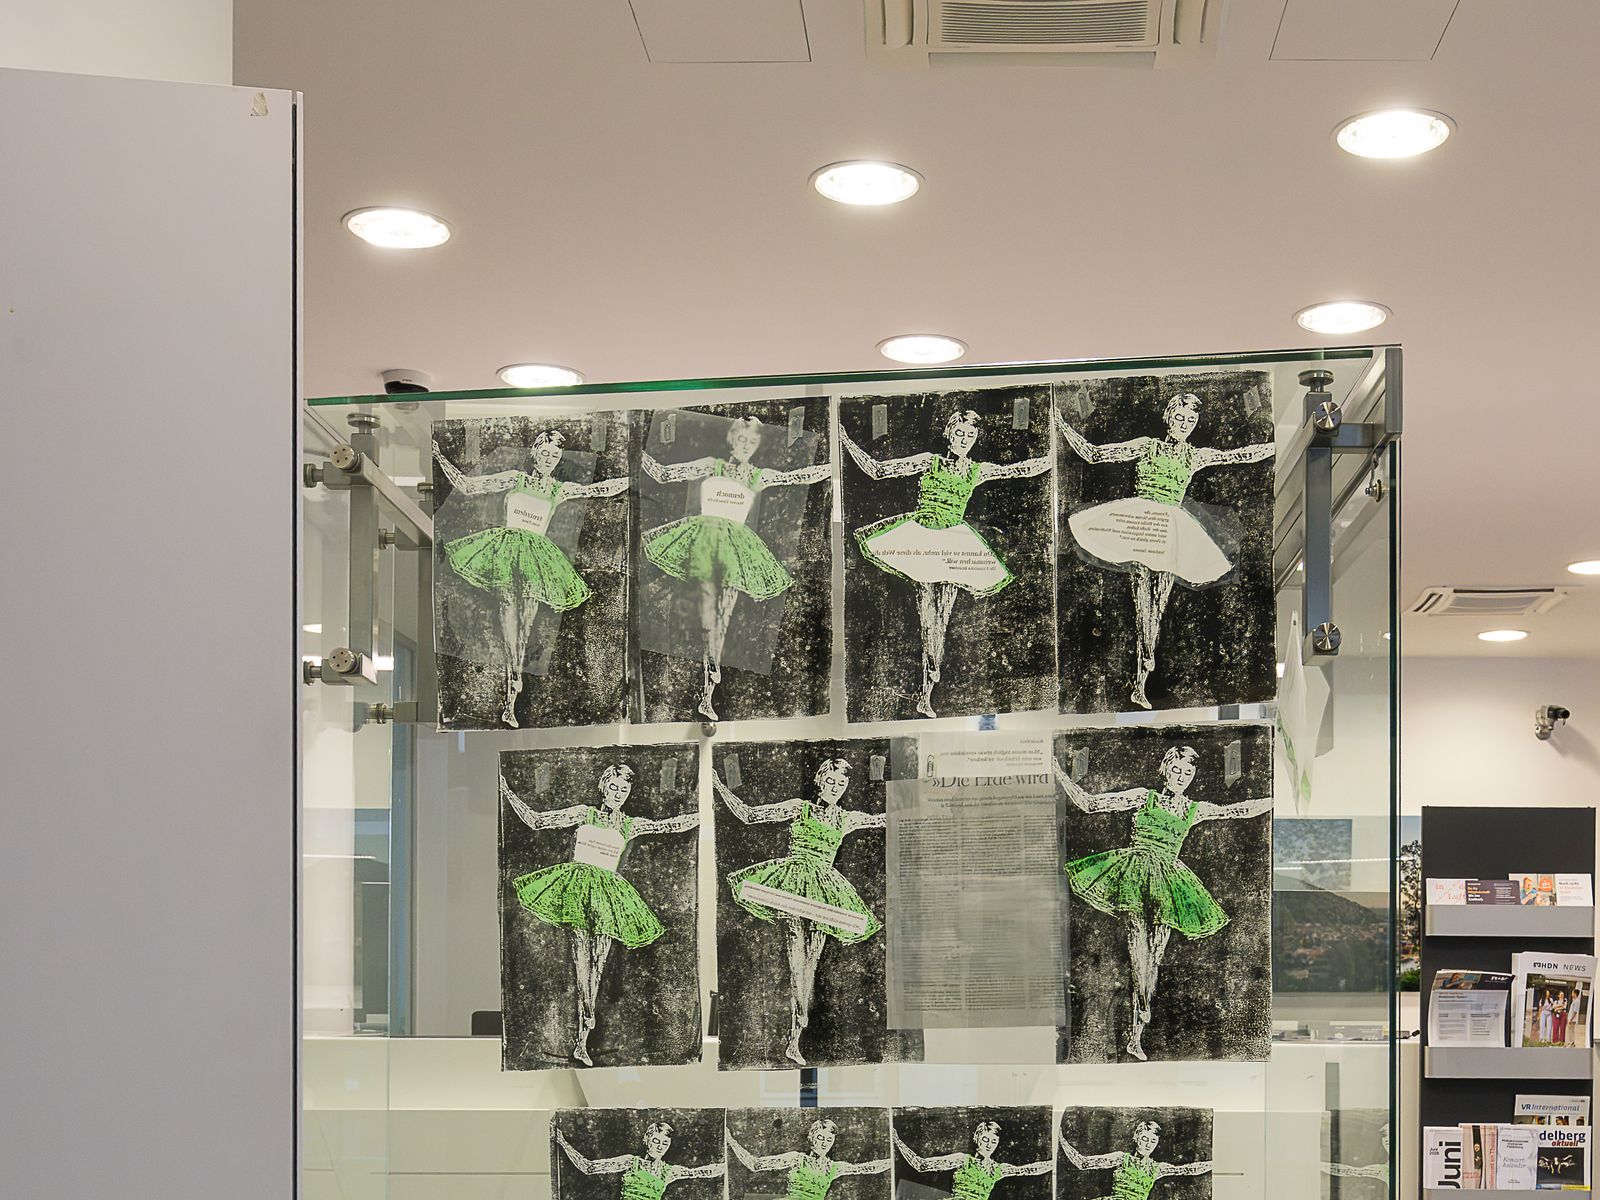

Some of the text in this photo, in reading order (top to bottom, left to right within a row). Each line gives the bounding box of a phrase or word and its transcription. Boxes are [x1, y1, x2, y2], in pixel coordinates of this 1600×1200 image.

[1563, 964, 1587, 972] NEWS
[1539, 1130, 1586, 1143] delberg
[1437, 1141, 1462, 1189] Juni
